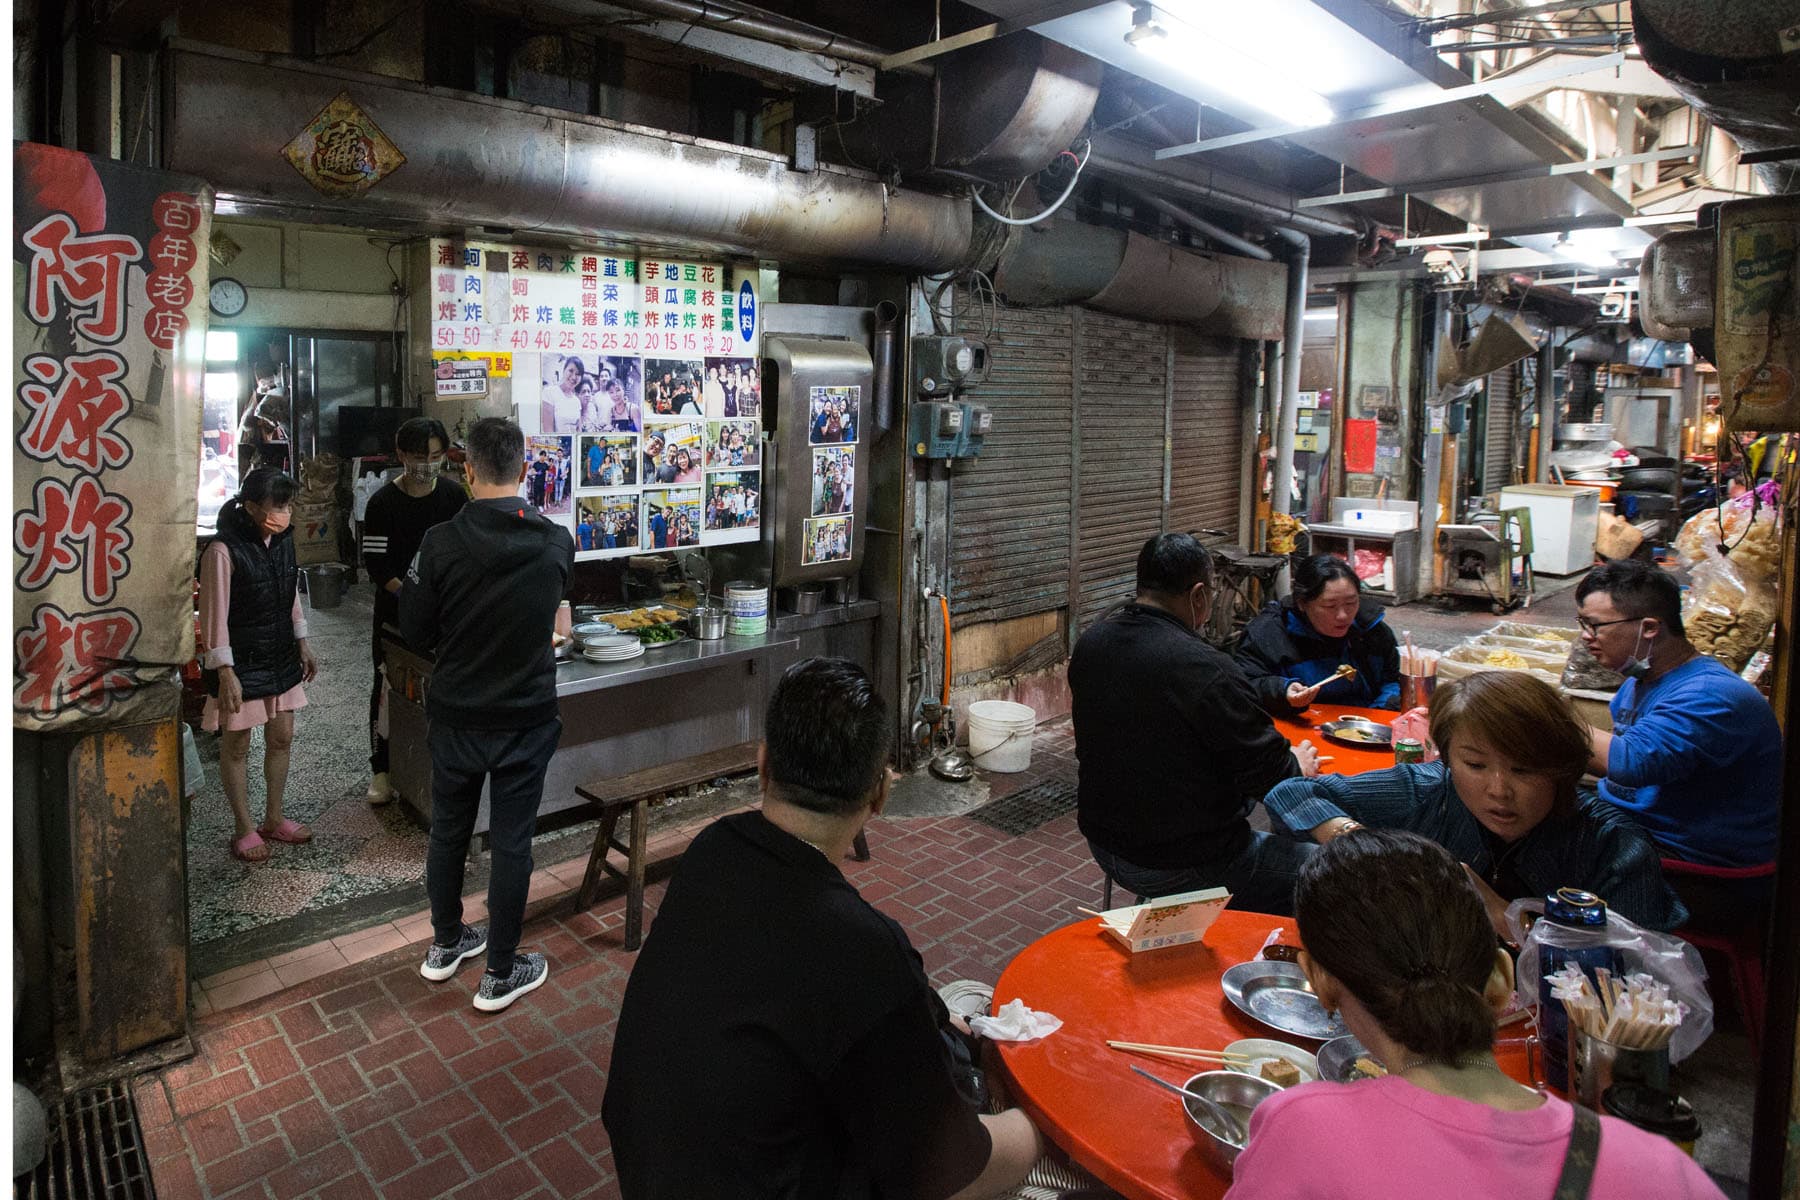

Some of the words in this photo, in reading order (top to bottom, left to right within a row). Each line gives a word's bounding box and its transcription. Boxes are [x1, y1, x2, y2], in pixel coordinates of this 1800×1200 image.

[150, 196, 197, 341] 百年老店
[464, 248, 482, 322] 蚵肉炸
[512, 251, 530, 323] 菜蚵炸
[537, 252, 553, 324] 肉炸
[560, 255, 575, 325] 米糕
[644, 262, 660, 328] 芋頭炸
[664, 263, 679, 329] 地瓜炸
[683, 264, 697, 329] 豆腐炸
[701, 266, 715, 330] 花枝炸
[437, 328, 455, 346] 50
[463, 326, 480, 345] 50
[511, 329, 528, 349] 40
[534, 330, 551, 349] 40
[559, 331, 575, 349] 25
[582, 332, 598, 350] 25
[601, 333, 618, 350] 25
[623, 333, 638, 350] 20
[644, 333, 659, 350] 20
[664, 333, 678, 351] 15
[683, 333, 696, 350] 15
[720, 336, 733, 353] 20
[741, 293, 753, 331] 飲料
[14, 213, 143, 716] 阿源炸粿
